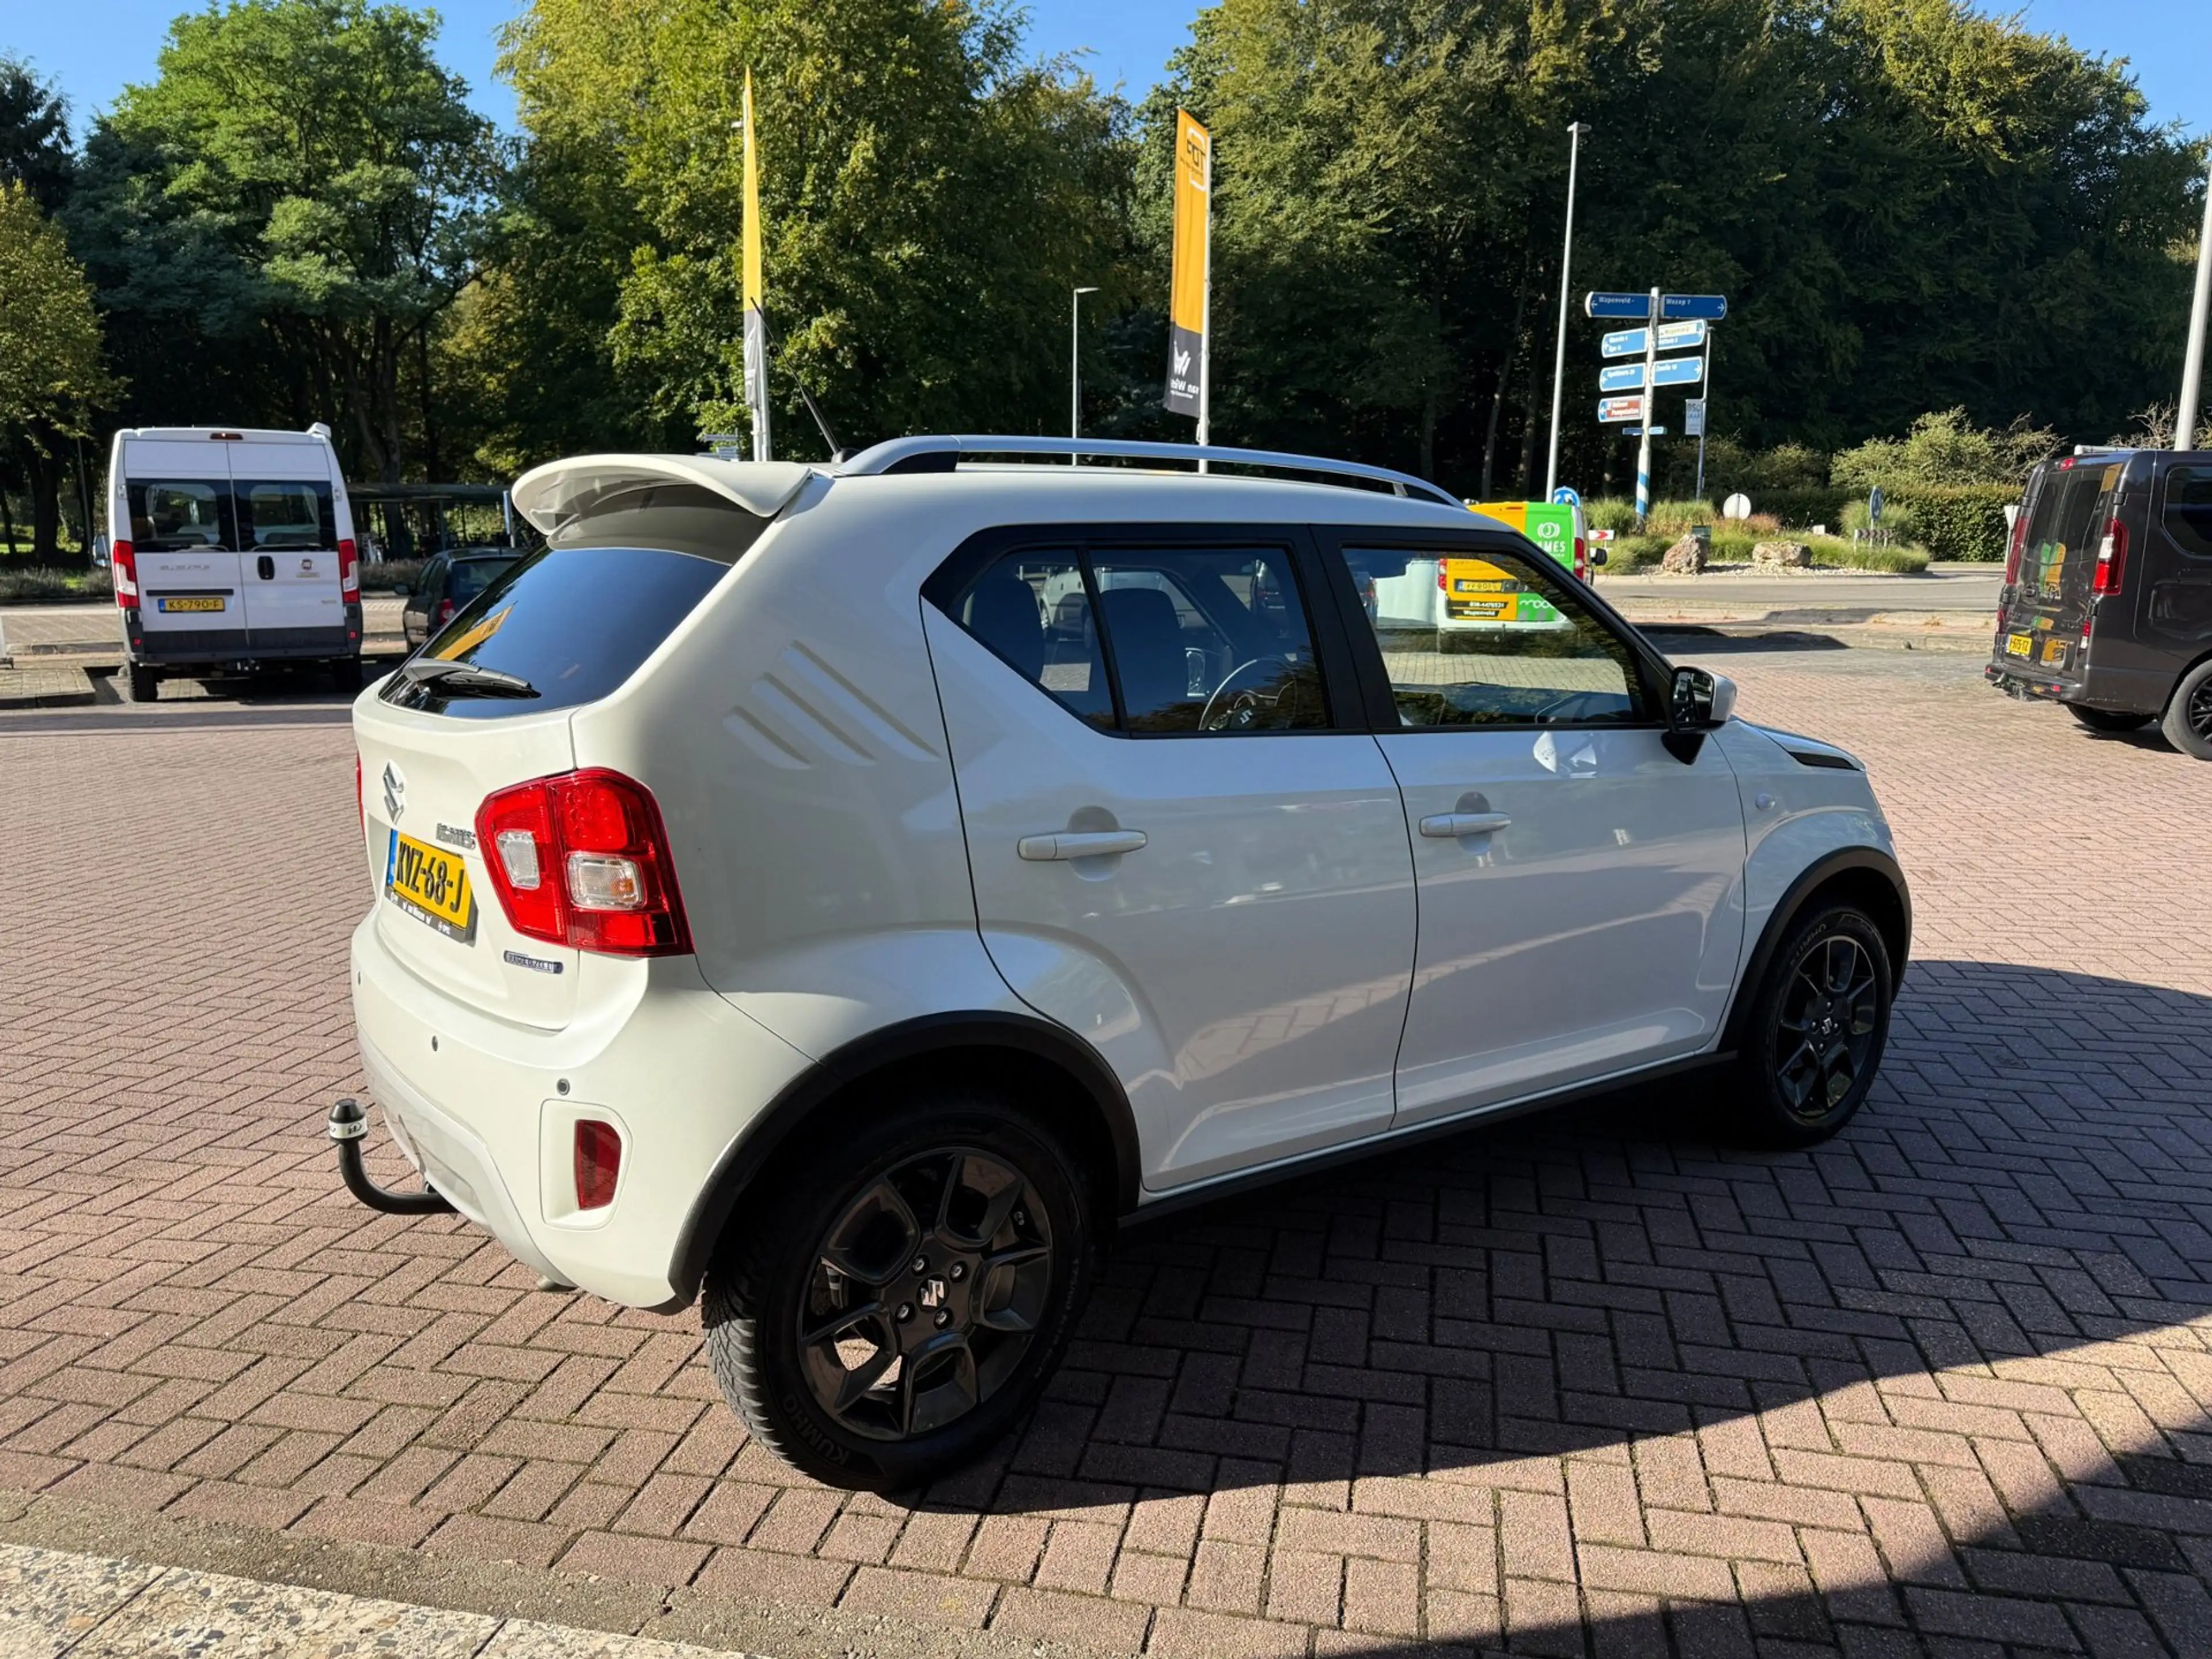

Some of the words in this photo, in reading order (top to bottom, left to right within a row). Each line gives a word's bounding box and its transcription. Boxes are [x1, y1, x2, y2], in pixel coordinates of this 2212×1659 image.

[168, 600, 219, 609] KS-790-F
[396, 840, 465, 914] KVZ-68-J
[782, 1393, 850, 1467] KUMHO
